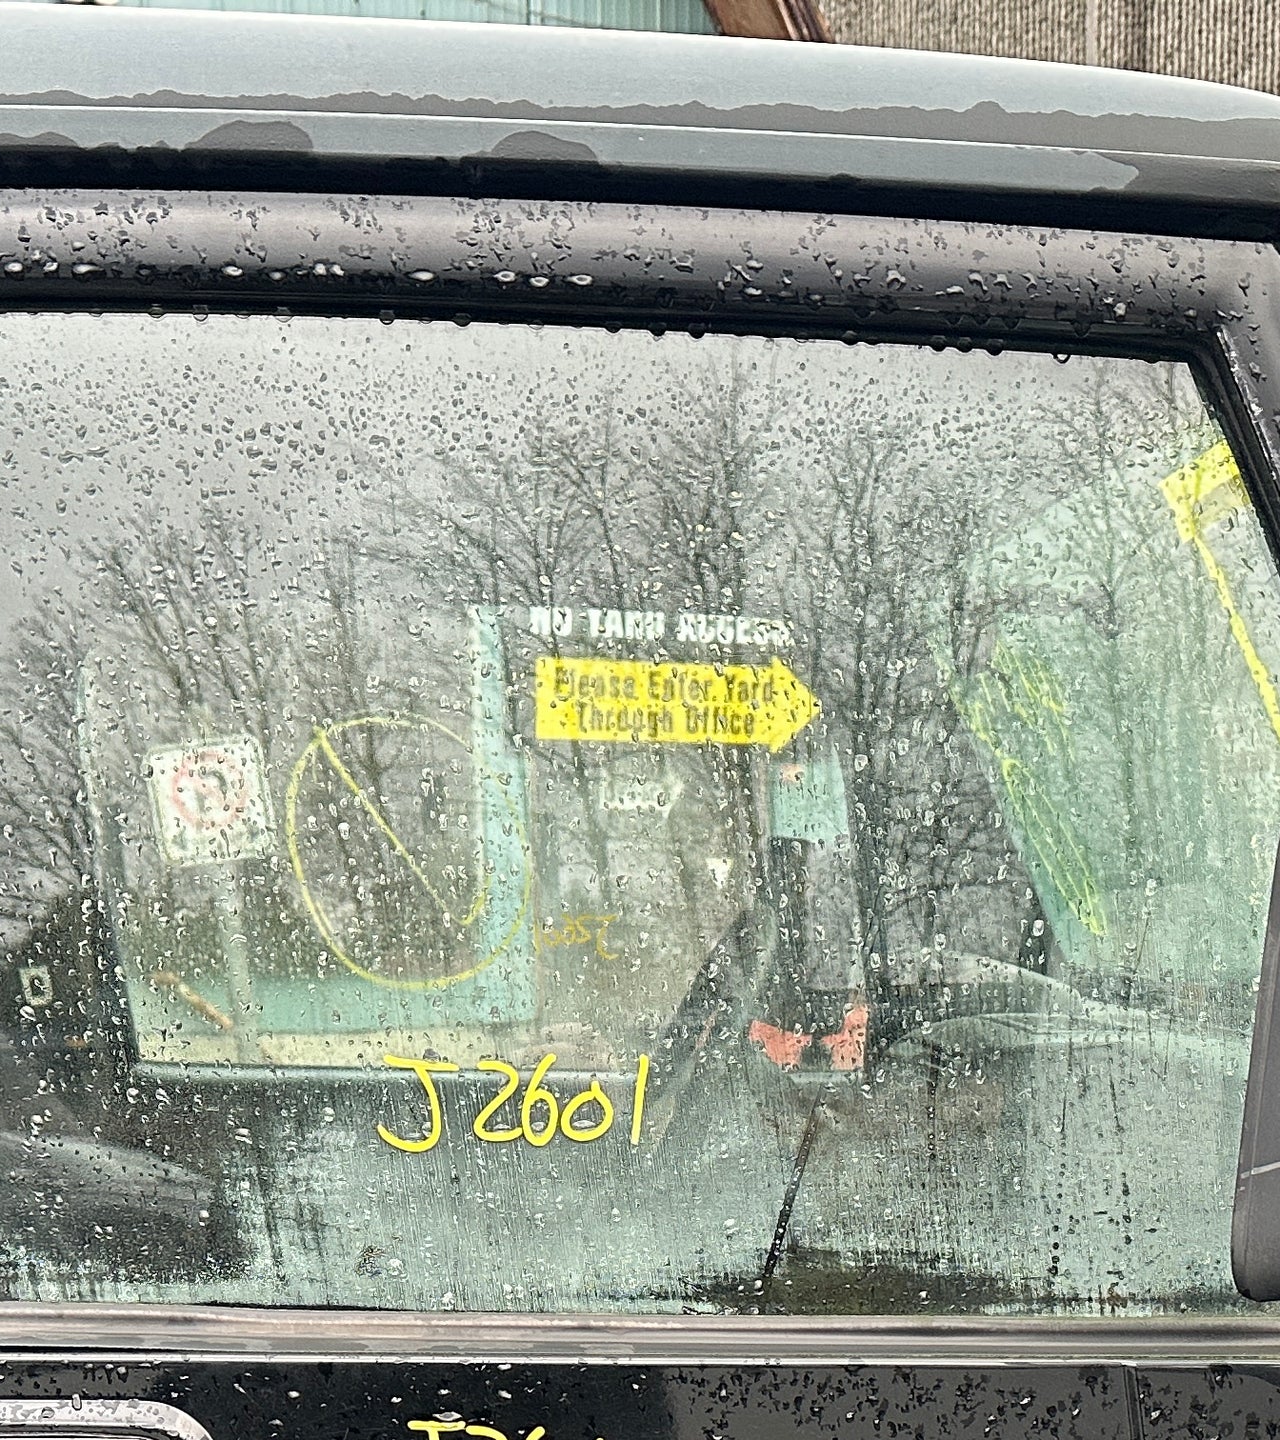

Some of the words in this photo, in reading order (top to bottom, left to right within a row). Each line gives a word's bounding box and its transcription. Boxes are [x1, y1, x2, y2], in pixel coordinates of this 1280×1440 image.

[554, 666, 637, 702] Please
[724, 671, 774, 702] Yard
[575, 700, 674, 737] Through
[377, 1053, 649, 1153] J2601
